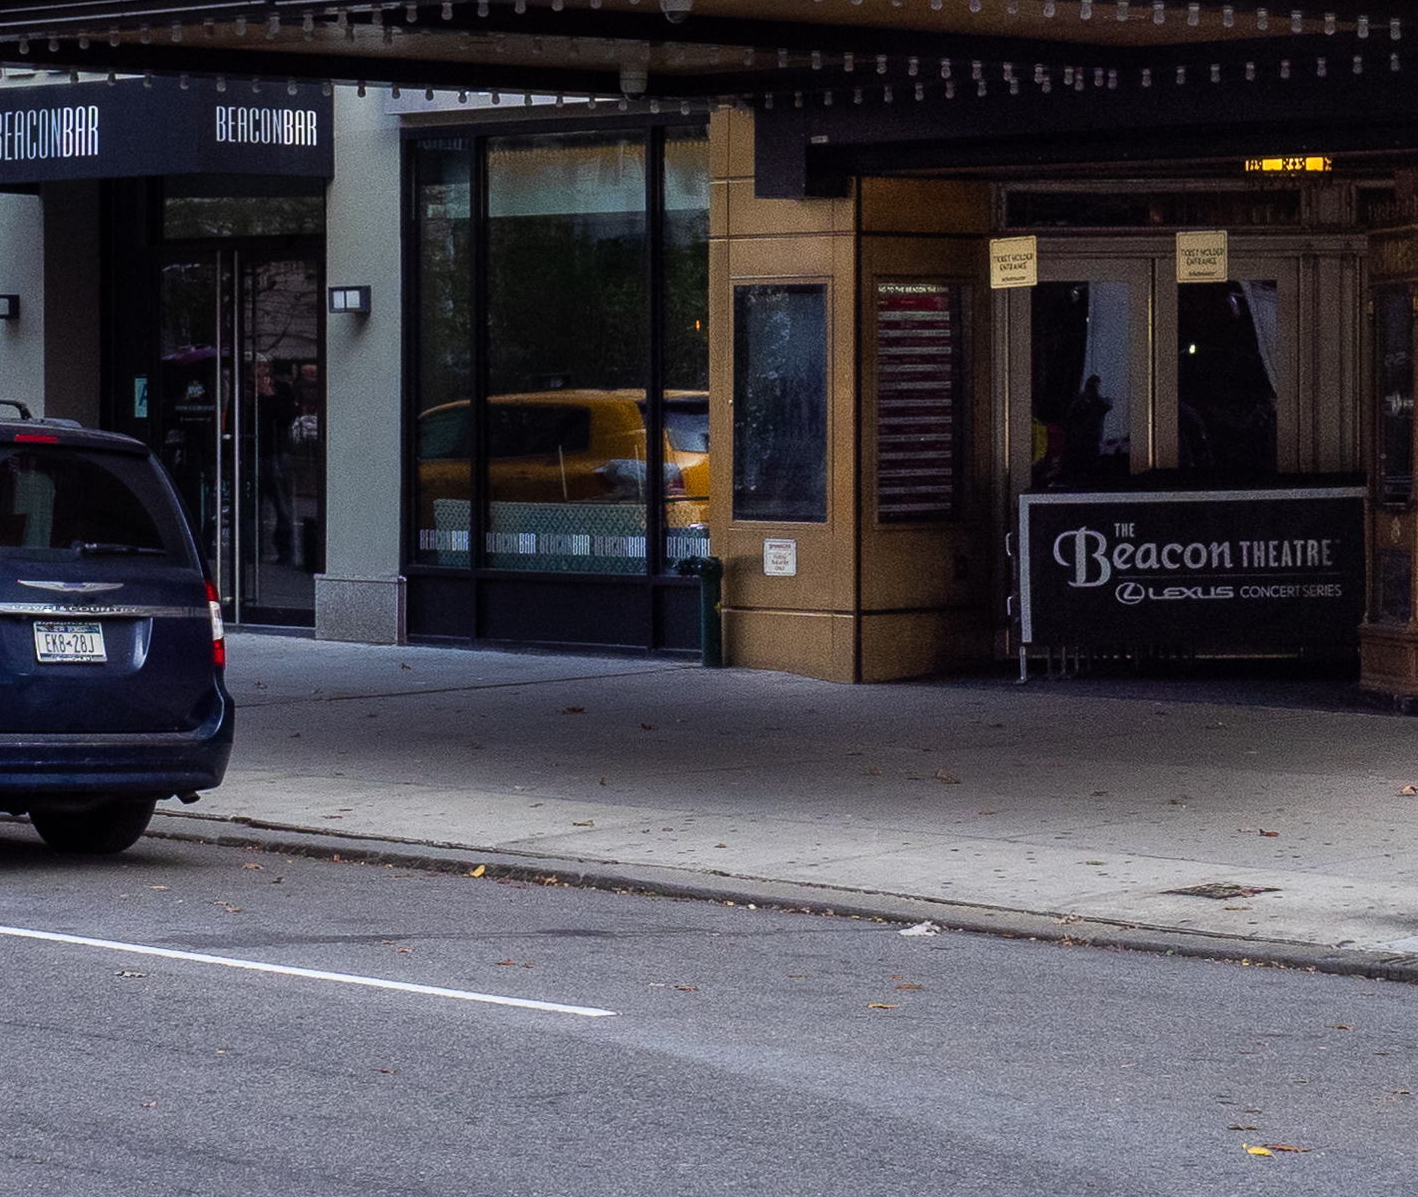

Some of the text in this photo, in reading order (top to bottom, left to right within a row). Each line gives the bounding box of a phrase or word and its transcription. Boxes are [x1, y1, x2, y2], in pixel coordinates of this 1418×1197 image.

[1114, 523, 1135, 538] THE
[1239, 539, 1334, 568] THEATRE
[1148, 586, 1235, 600] LEXUS
